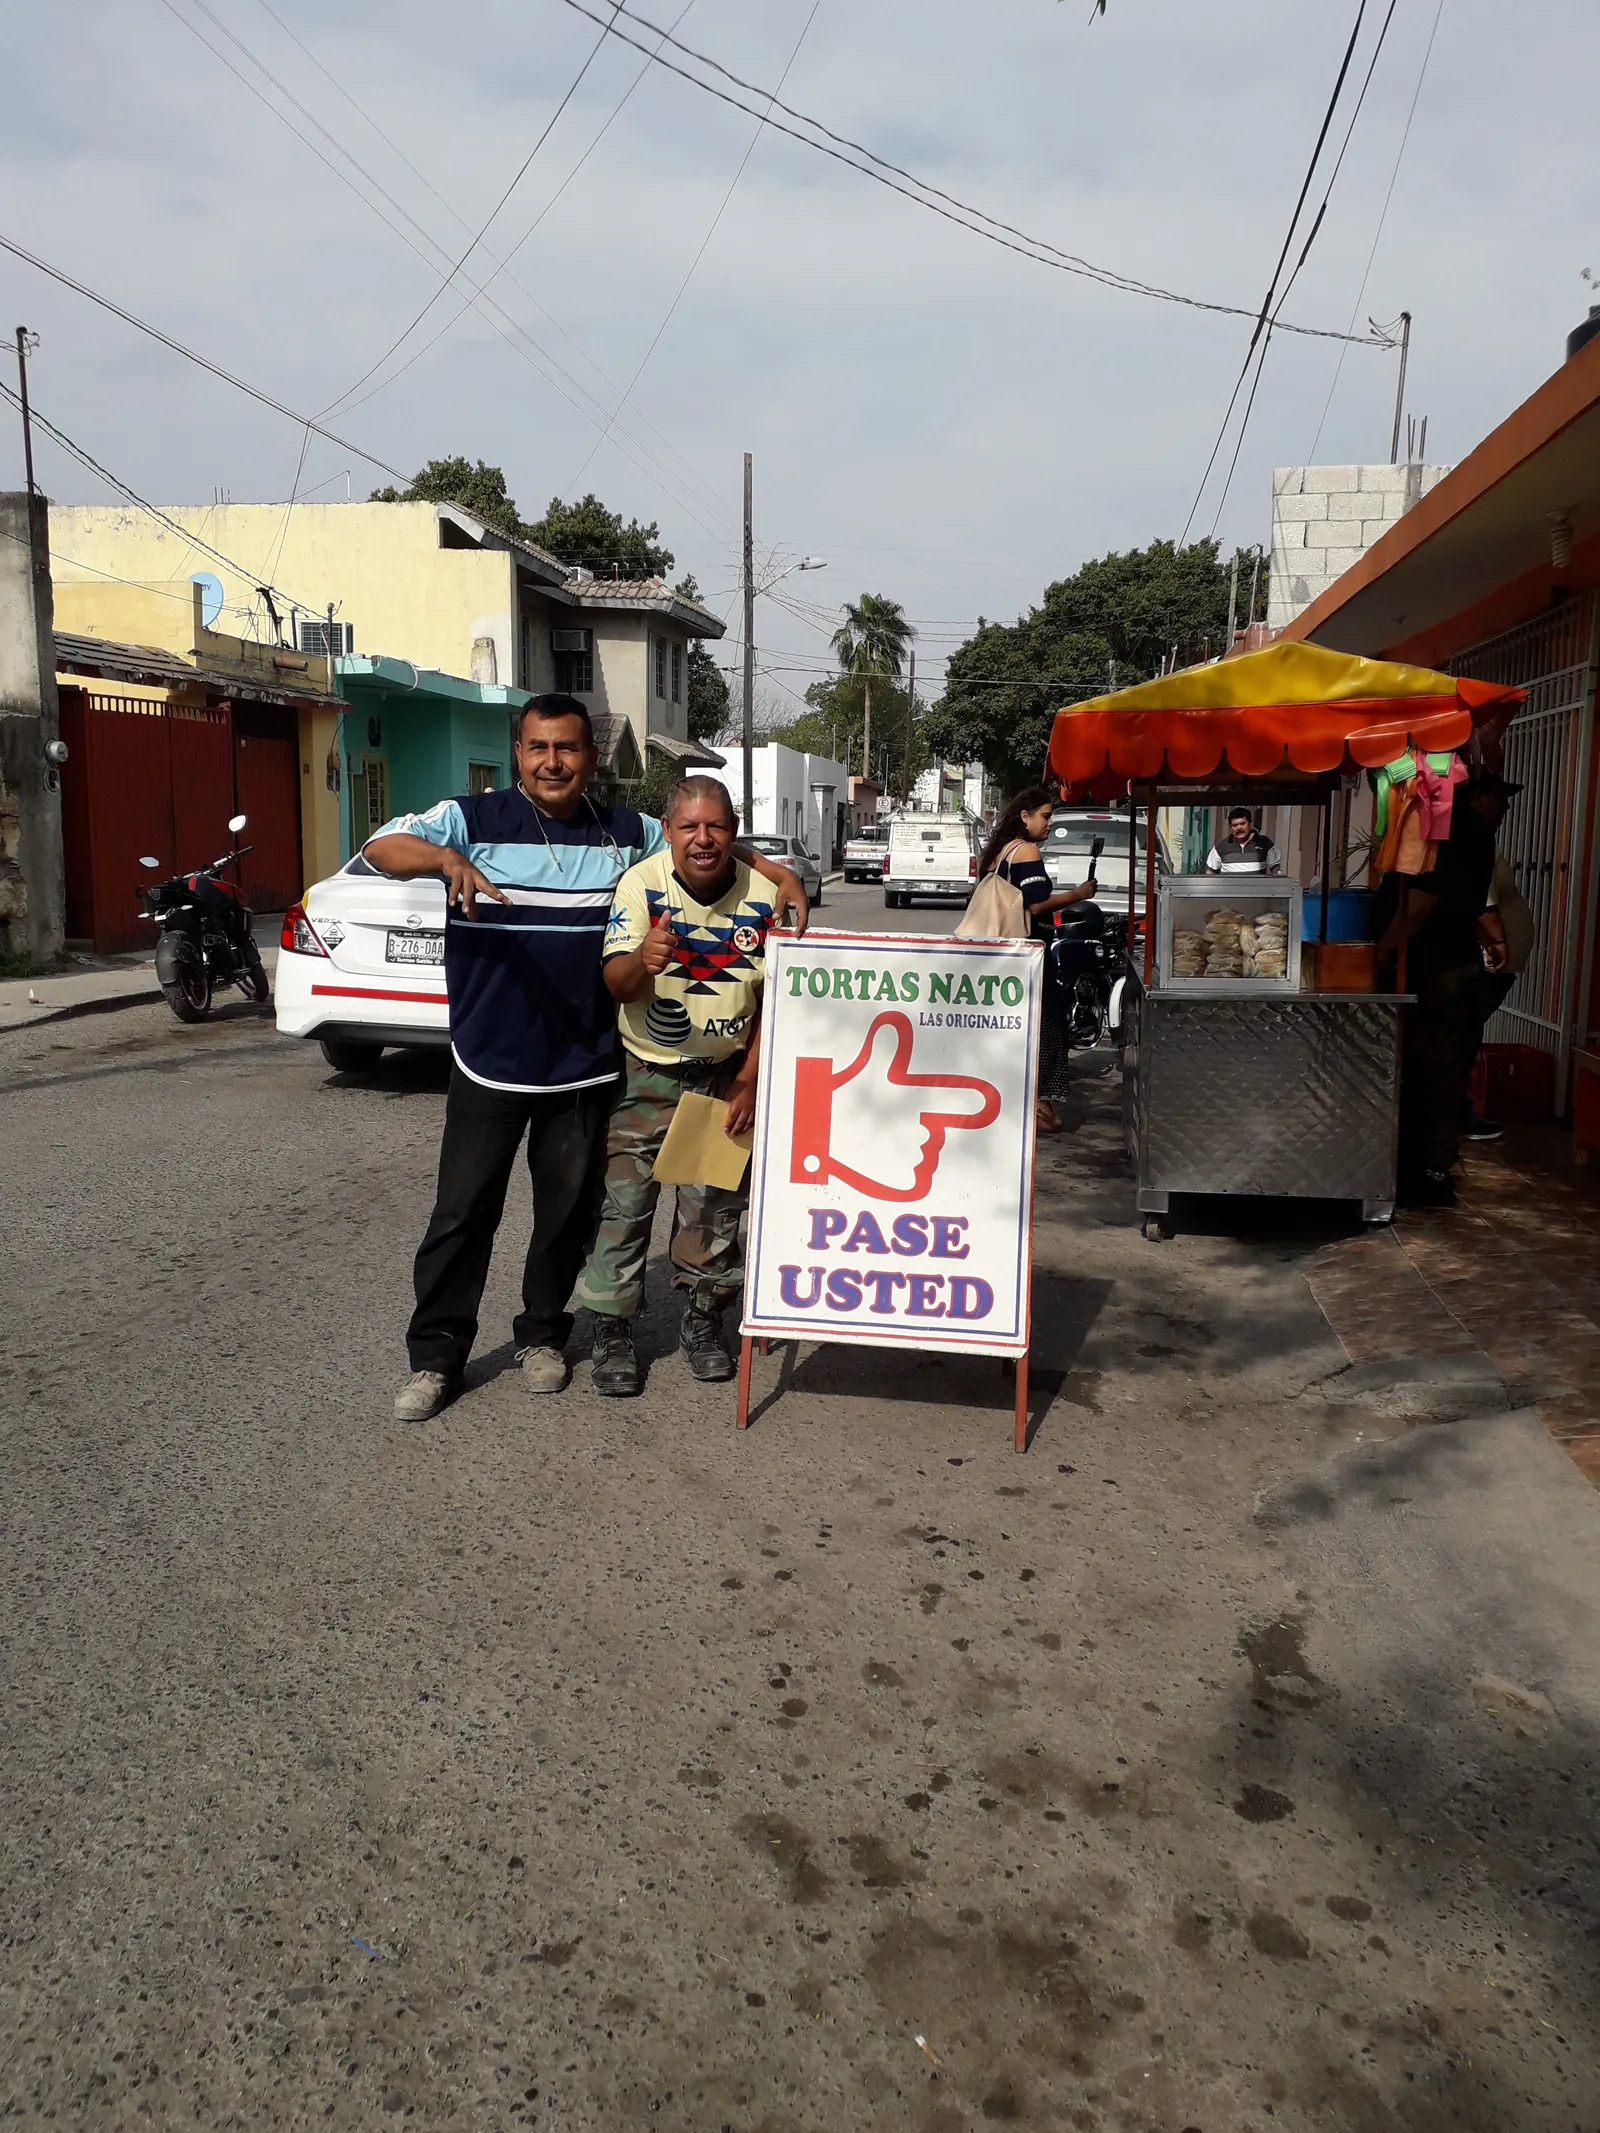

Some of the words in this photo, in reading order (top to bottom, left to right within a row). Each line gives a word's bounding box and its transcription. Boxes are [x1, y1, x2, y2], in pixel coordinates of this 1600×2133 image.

[389, 938, 443, 955] B-276-DAA
[786, 966, 920, 1003] TORTAS
[928, 972, 1024, 1007] NATO
[702, 1015, 749, 1037] AT&T
[919, 1012, 943, 1027] LAS
[945, 1013, 1022, 1030] ORIGINALES
[807, 1208, 971, 1260] PASE
[778, 1265, 995, 1320] USTED
